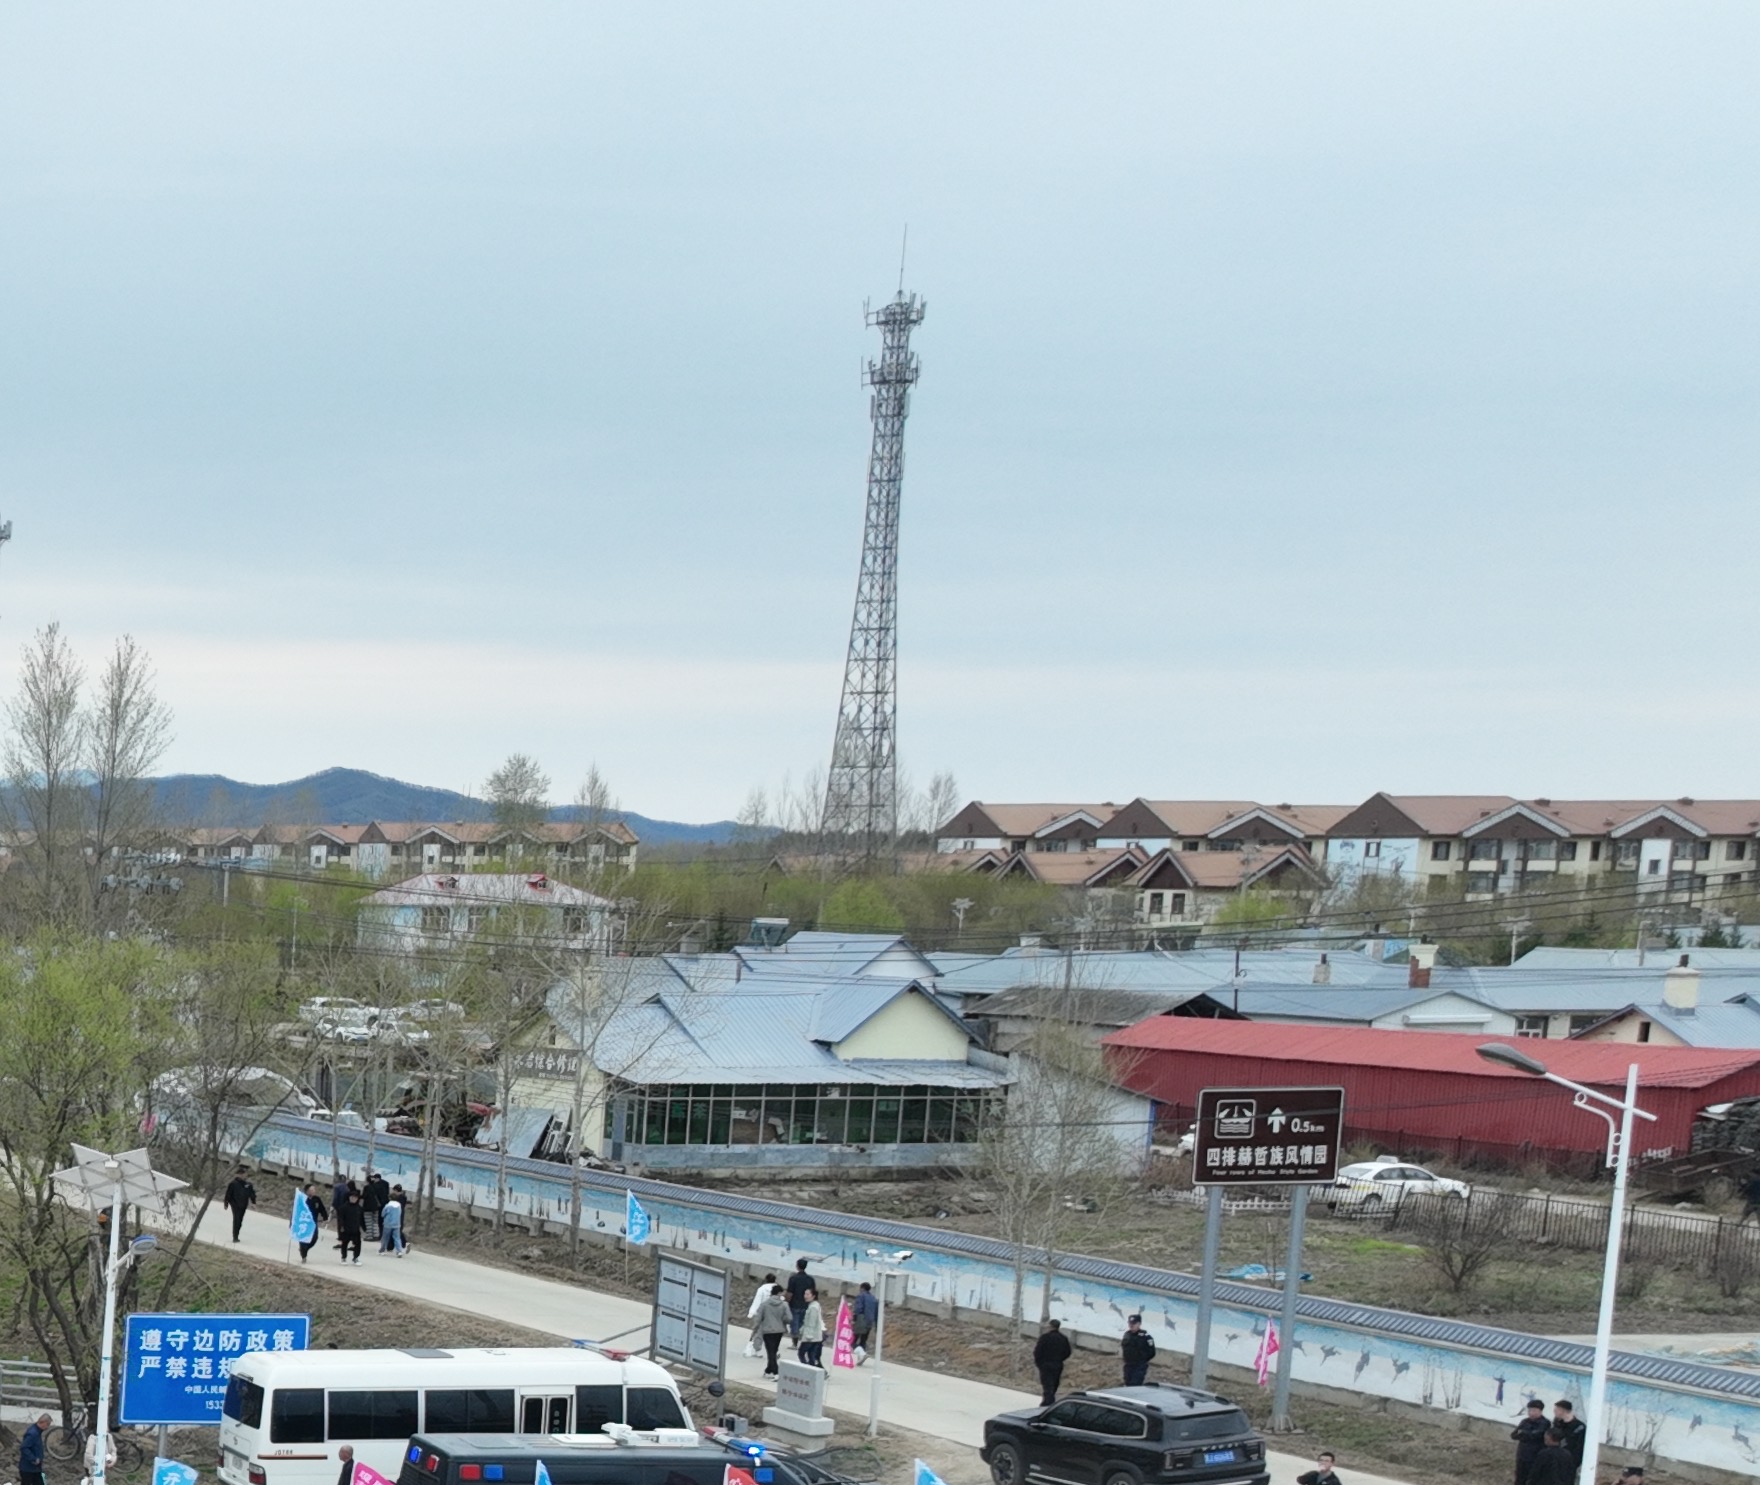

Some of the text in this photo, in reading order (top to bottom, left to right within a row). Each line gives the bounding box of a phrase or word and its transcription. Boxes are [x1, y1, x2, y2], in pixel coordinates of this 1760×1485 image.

[1206, 1145, 1328, 1167] 四排赫哲族风情园
[139, 1328, 295, 1351] 遵守边防政策
